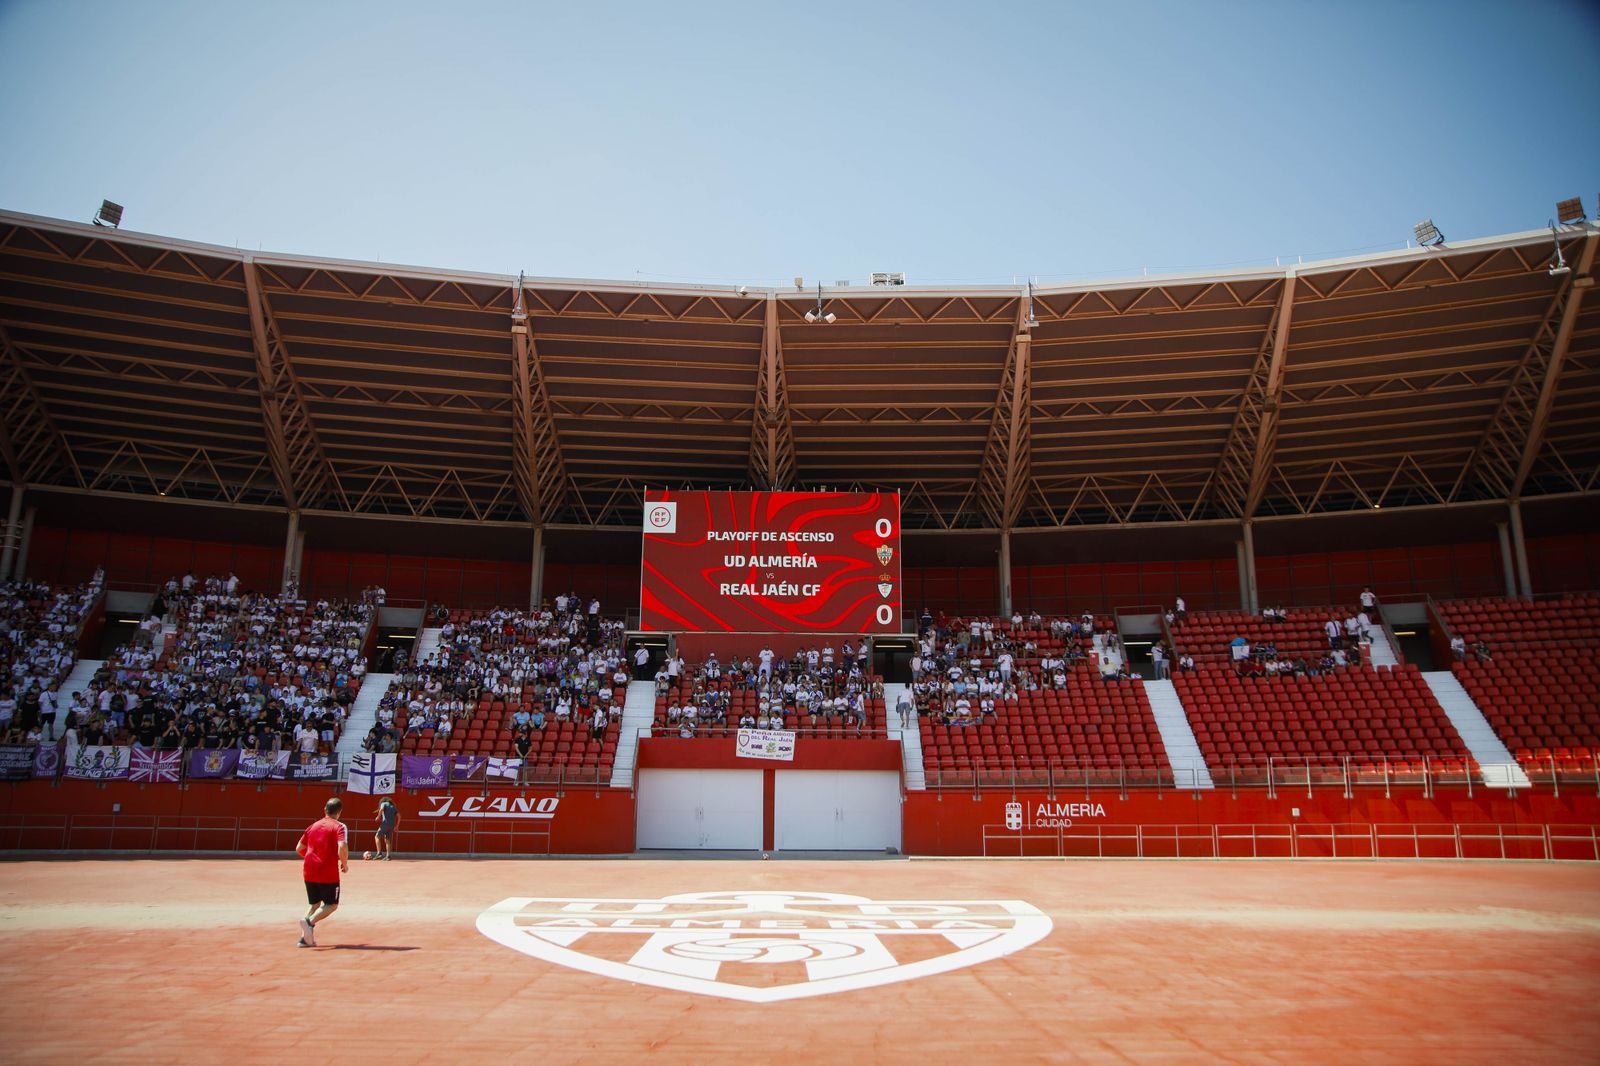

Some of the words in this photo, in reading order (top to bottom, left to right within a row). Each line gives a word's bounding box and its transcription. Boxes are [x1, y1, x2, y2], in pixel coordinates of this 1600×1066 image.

[875, 518, 892, 538] 0
[707, 531, 759, 542] PLAYOFF
[761, 531, 777, 542] DE
[779, 532, 835, 542] ASCENSO
[724, 555, 746, 568] UD
[748, 552, 818, 568] ALMERÍA
[720, 583, 759, 596] REAL
[761, 580, 799, 596] JAÉN
[802, 583, 821, 596] CF
[876, 604, 893, 625] 0
[67, 768, 102, 778] YOUNG
[1036, 803, 1106, 817] ALMERIA
[1036, 818, 1072, 828] CIUDAD
